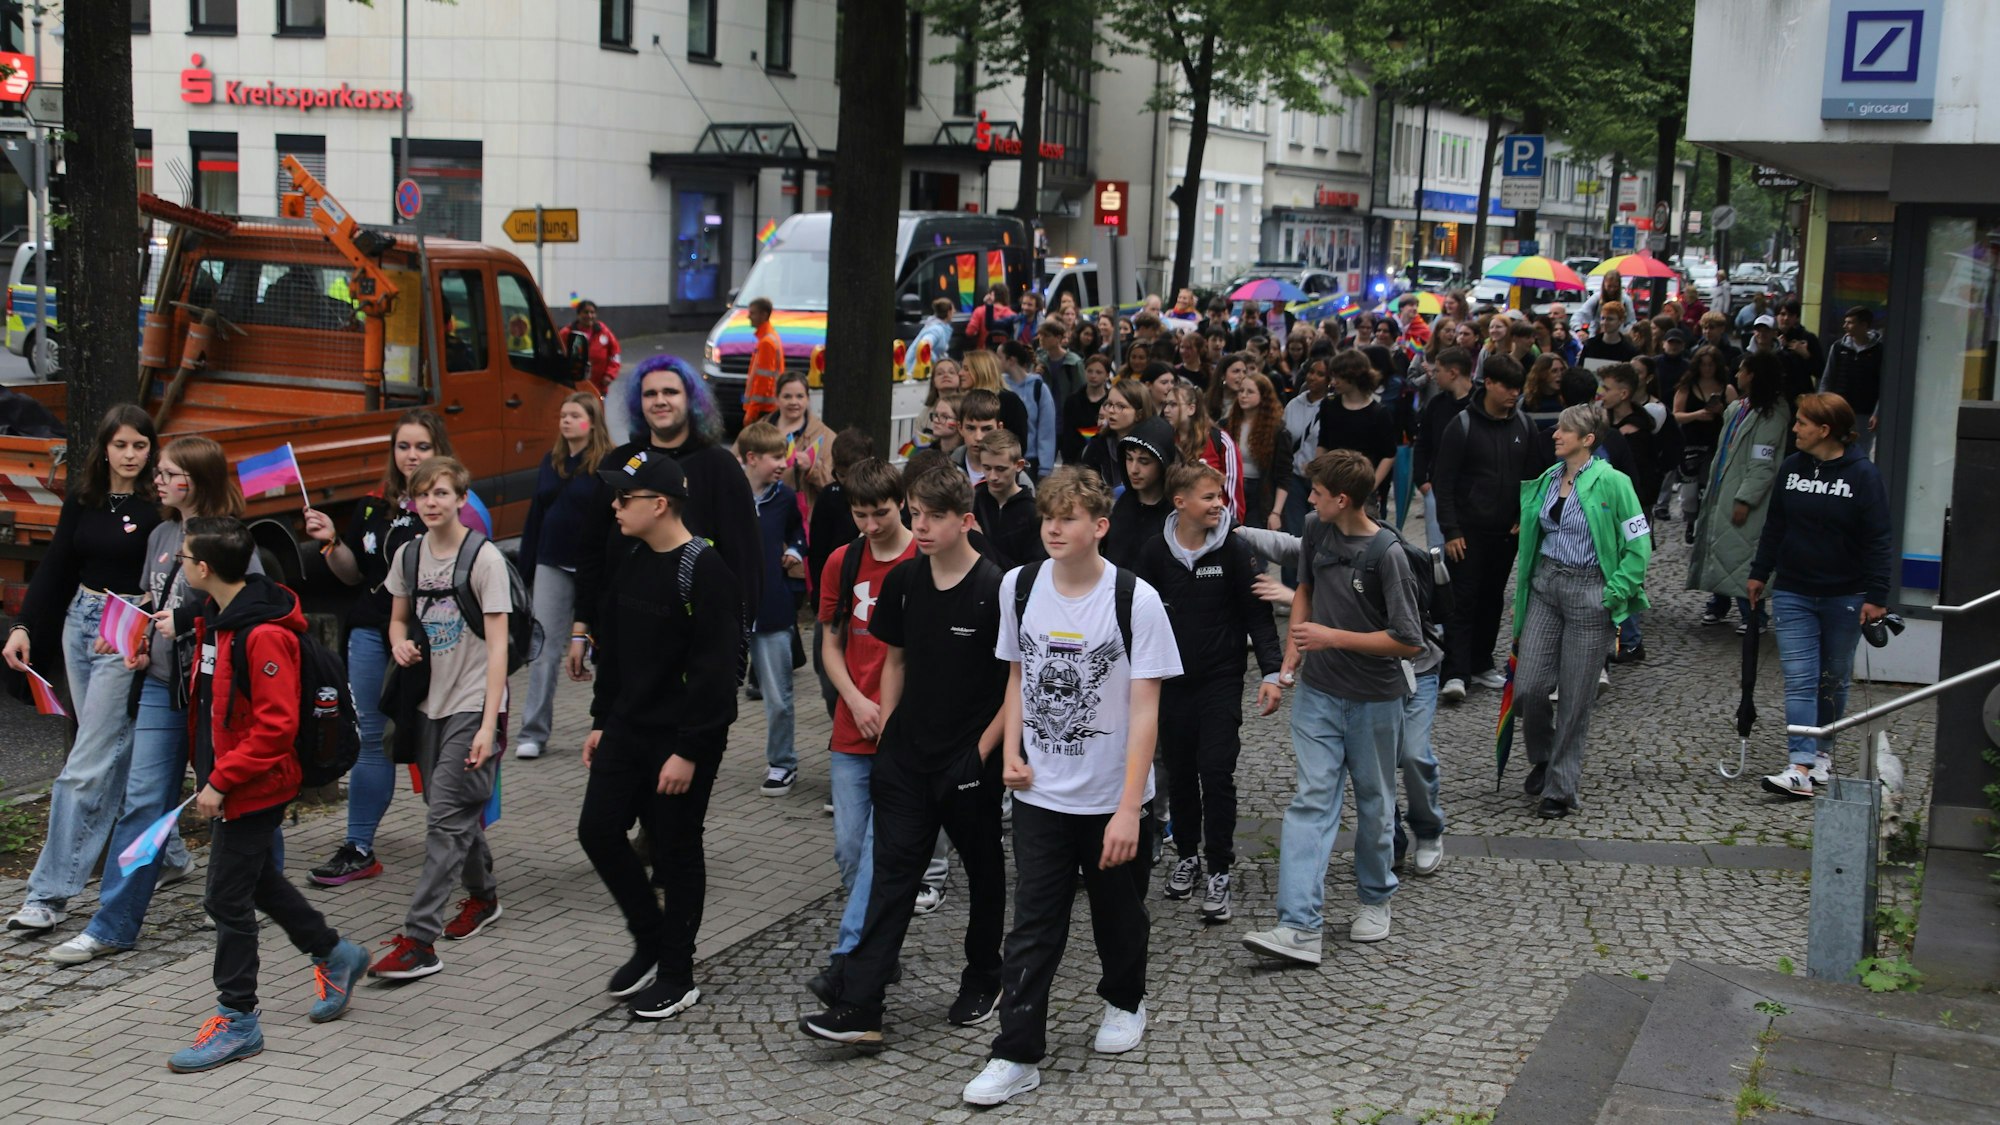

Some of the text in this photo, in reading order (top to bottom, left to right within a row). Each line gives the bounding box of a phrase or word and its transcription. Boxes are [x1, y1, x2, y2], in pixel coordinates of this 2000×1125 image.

[1859, 102, 1909, 116] girocard
[1512, 140, 1535, 172] P
[1785, 473, 1853, 498] Bench.
[1052, 743, 1062, 755] IN
[1064, 742, 1085, 757] HELL
